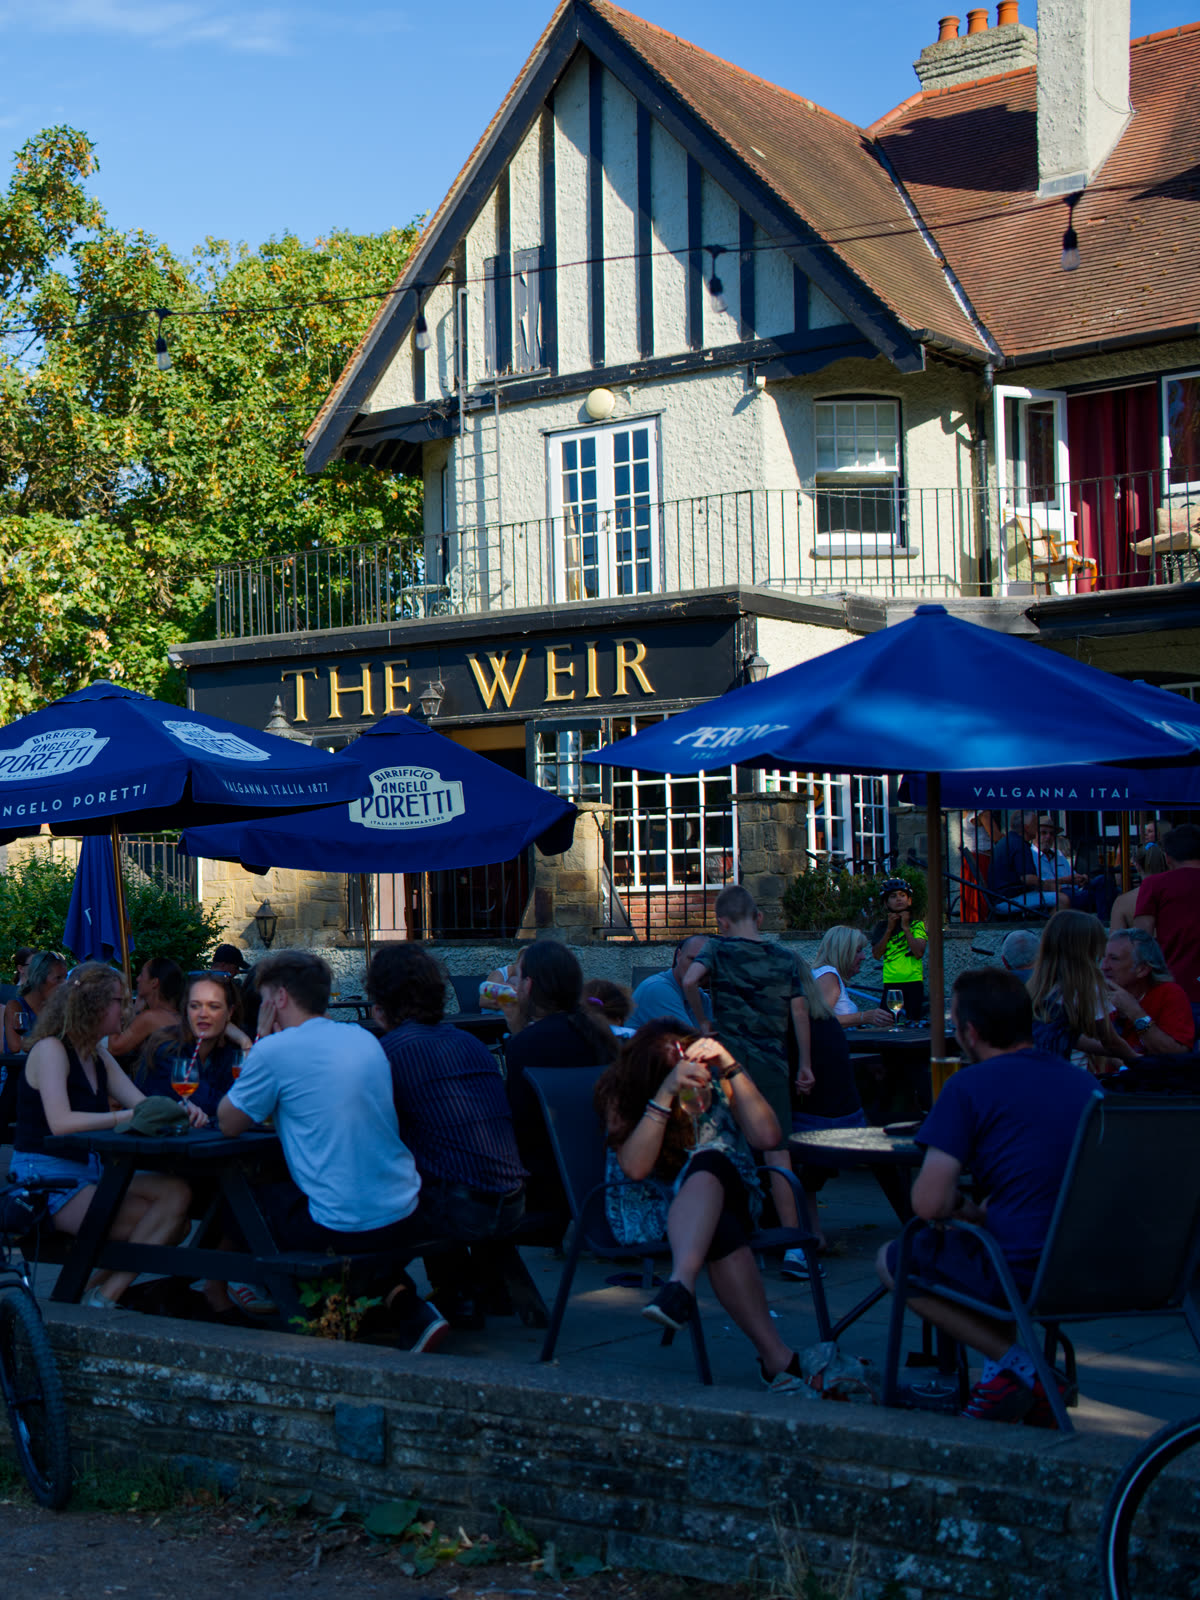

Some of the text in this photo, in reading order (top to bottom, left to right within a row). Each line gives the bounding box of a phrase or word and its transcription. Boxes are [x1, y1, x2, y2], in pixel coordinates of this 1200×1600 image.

[281, 637, 657, 722] THE WEIR
[29, 733, 80, 754] ANGELO
[33, 730, 92, 745] BIRRIFICIO
[374, 769, 434, 782] BIRRIFICIO
[72, 783, 148, 808] PORETTI
[223, 779, 329, 796] VALGANNA ITALIA 1877
[381, 780, 427, 794] ANGELO
[973, 787, 1079, 798] VALGANNA
[361, 789, 453, 819] PORETTI
